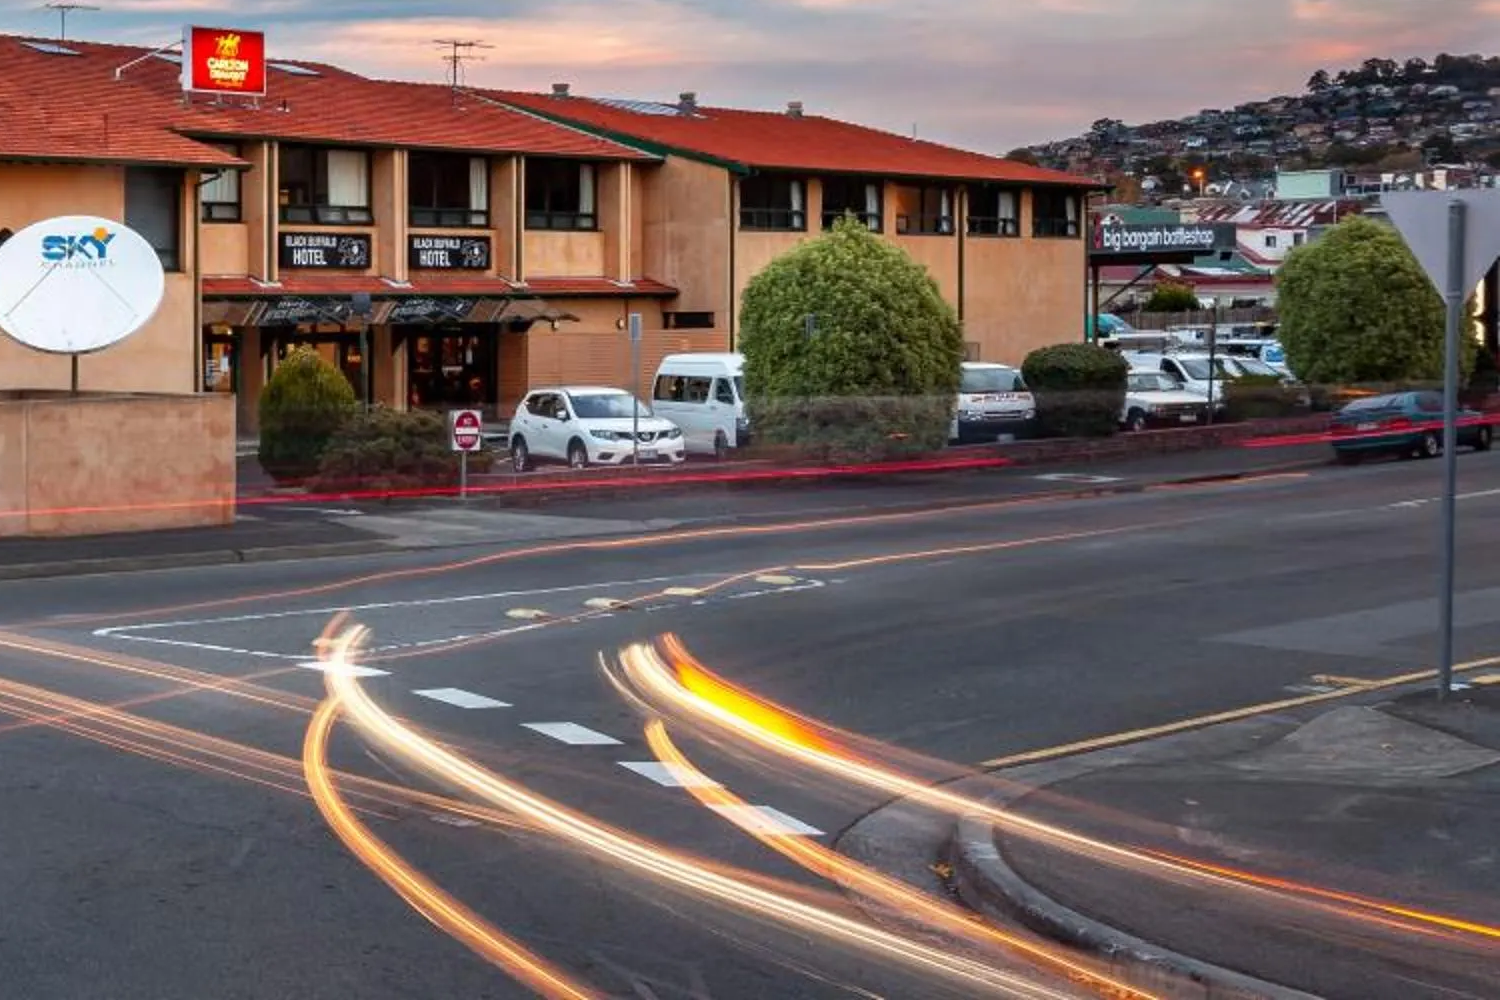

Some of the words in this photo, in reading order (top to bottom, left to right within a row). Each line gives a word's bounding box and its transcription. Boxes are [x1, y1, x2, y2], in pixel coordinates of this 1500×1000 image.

[42, 233, 116, 260] SKY
[285, 235, 307, 248] BLACK
[307, 236, 337, 248] BUFFALO
[413, 237, 433, 249] BLACK
[433, 238, 461, 250] BUFFALO
[1103, 227, 1121, 251] big
[1121, 226, 1163, 252] bargain
[292, 248, 328, 265] HOTEL
[419, 250, 451, 267] HOTEL
